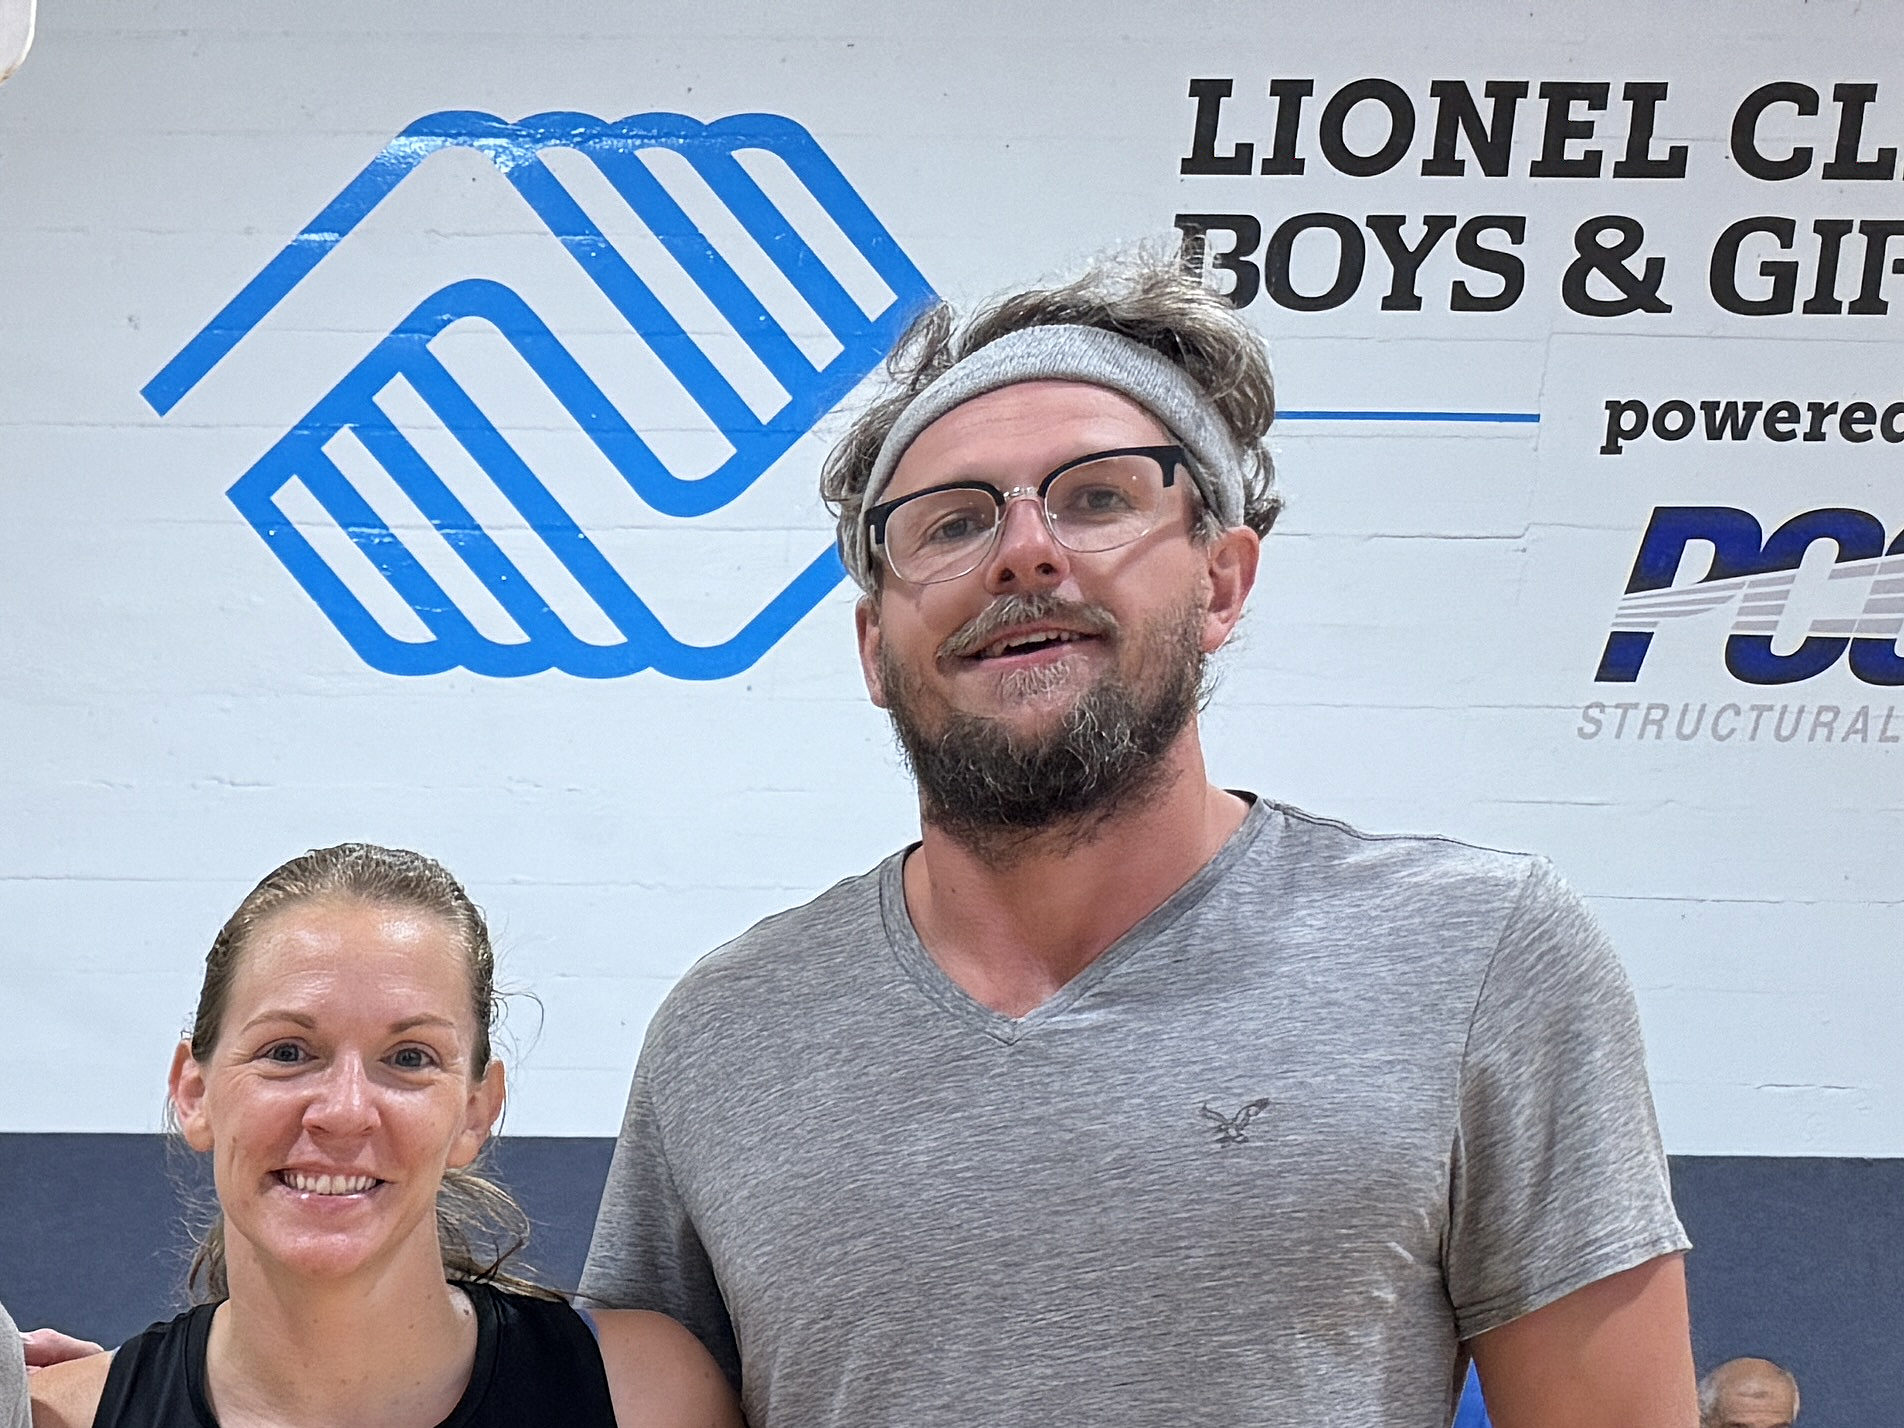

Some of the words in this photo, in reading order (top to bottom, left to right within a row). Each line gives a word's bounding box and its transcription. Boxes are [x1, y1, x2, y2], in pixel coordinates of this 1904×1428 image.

[1180, 78, 1688, 178] LIONEL
[1730, 80, 1904, 181] CL
[1174, 212, 1526, 312] BOYS
[1561, 215, 1672, 315] &
[1577, 702, 1900, 743] STRUCTURAL
